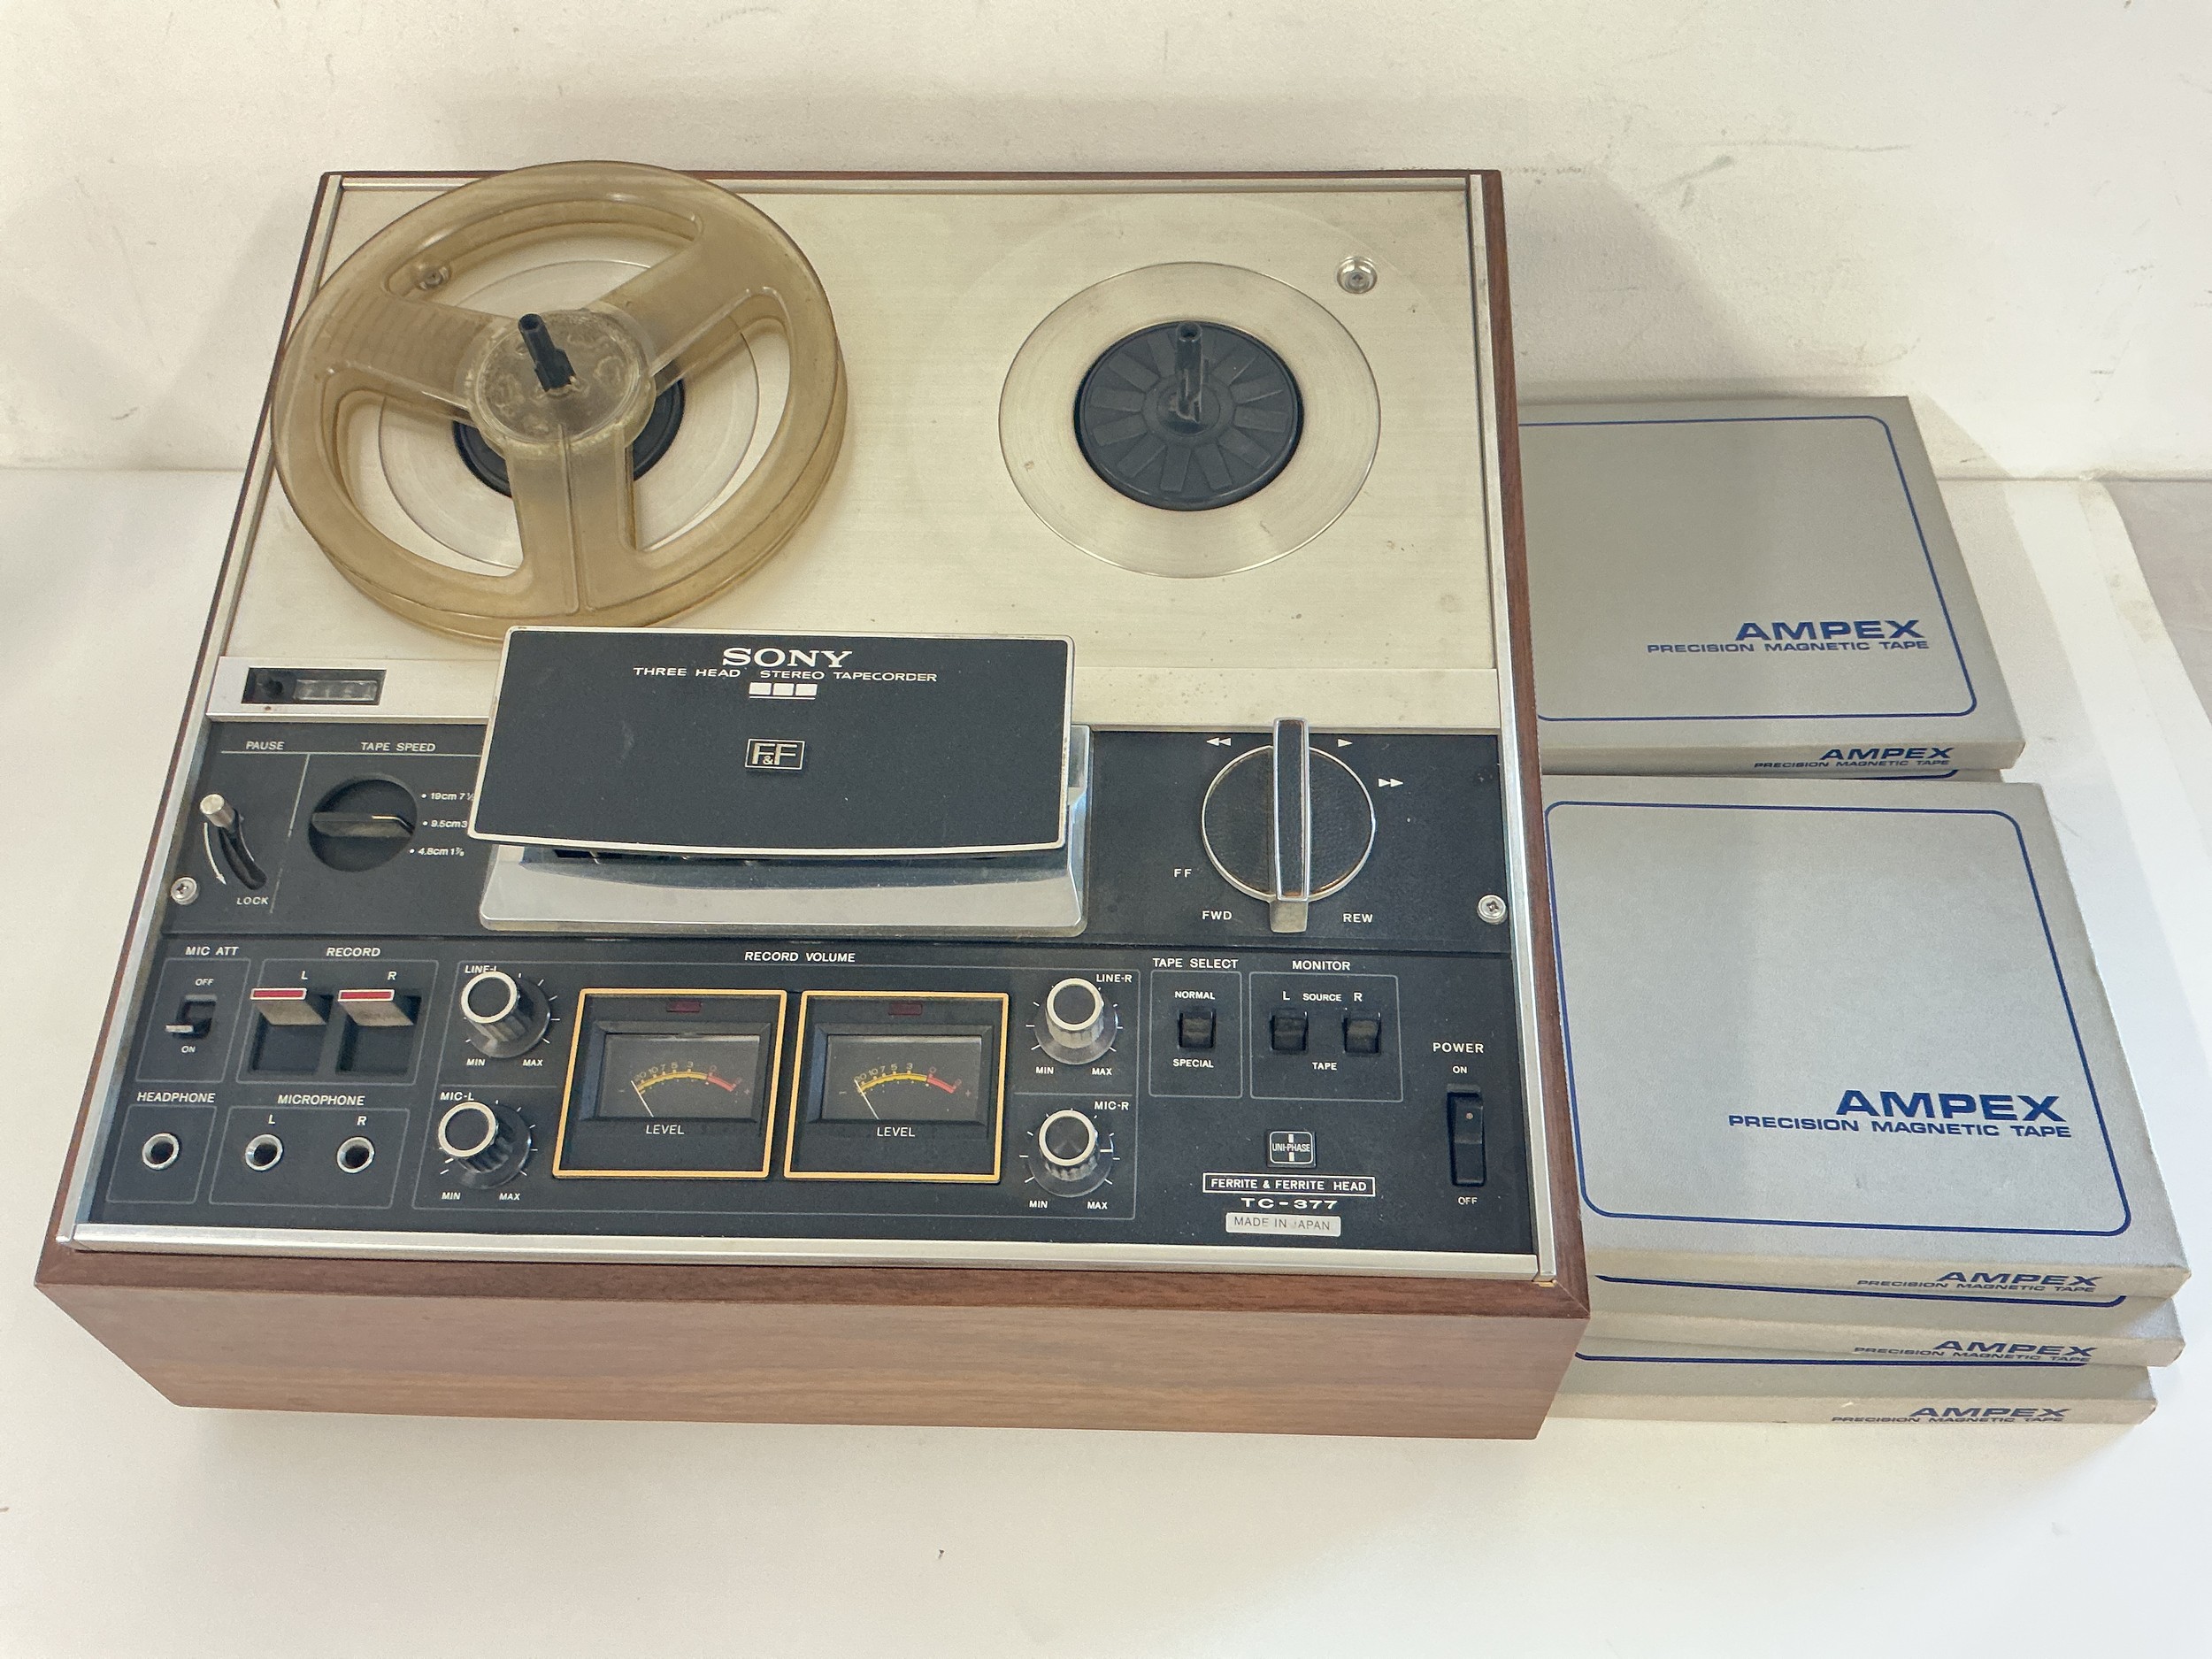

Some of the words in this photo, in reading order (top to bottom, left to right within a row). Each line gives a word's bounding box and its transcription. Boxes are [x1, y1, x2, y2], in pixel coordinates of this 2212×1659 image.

[1735, 620, 1924, 641] AMPEX
[1647, 644, 1754, 653] PRECISION
[1765, 641, 1870, 651] MAGNETIC
[1879, 641, 1929, 649] TAPE
[722, 647, 852, 668] SONY
[633, 667, 687, 676] THREE
[760, 670, 825, 680] STEREO
[833, 672, 937, 682] TAPECORDER
[246, 741, 285, 750] PAUSE
[361, 741, 390, 751] TAPE
[396, 742, 435, 752] SPEED
[1820, 748, 1955, 760] AMPEX
[237, 896, 268, 905] LOCK
[1202, 910, 1233, 920] FWD
[1343, 913, 1373, 923] REW
[185, 947, 210, 956] MIC
[216, 947, 239, 956] ATT
[326, 948, 380, 957] RECORD
[744, 951, 798, 962] RECORD
[806, 952, 856, 963] VOLUME
[1153, 958, 1183, 969] TAPE
[1190, 957, 1238, 969] SELECT
[1292, 960, 1350, 972] MONITOR
[302, 971, 308, 980] L
[388, 972, 396, 980] R
[1095, 974, 1132, 983] LINE-R
[1174, 990, 1215, 1000] NORMAL
[1283, 992, 1290, 1001] L
[1354, 992, 1362, 1002] R
[1432, 1042, 1484, 1054] POWER
[1173, 1058, 1214, 1068] SPECIAL
[1312, 1062, 1337, 1071] TAPE
[1036, 1066, 1054, 1075] MIN
[1092, 1066, 1112, 1076] MAX
[137, 1093, 215, 1103] HEADPHONE
[278, 1094, 365, 1106] MICROPHONE
[441, 1092, 474, 1101] MIC-L
[1094, 1101, 1129, 1110] MIC-R
[1835, 1090, 2068, 1122] AMPEX
[269, 1115, 275, 1125] L
[357, 1116, 366, 1125] R
[646, 1125, 684, 1134] LEVEL
[877, 1126, 915, 1137] LEVEL
[1729, 1115, 1859, 1131] PRECISION
[1871, 1121, 2000, 1136] MAGNETIC
[2010, 1125, 2071, 1138] TAPE
[1271, 1143, 1310, 1153] UNI-PHASE
[1210, 1179, 1258, 1189] FERRITE
[1263, 1179, 1270, 1188] &
[1275, 1179, 1325, 1191] FERRITE
[1333, 1181, 1366, 1191] HEAD
[1029, 1200, 1048, 1209] MIN
[1087, 1201, 1108, 1210] MAX
[1240, 1198, 1339, 1210] TC-377
[1458, 1196, 1478, 1205] OFF
[1234, 1217, 1269, 1226] MADE
[1275, 1219, 1286, 1228] IN
[1857, 1279, 1948, 1288] PRECISION
[1936, 1271, 2102, 1286] AMPEX
[1933, 1340, 2097, 1357] AMPEX
[1855, 1348, 1944, 1356] PRECISION
[1953, 1352, 2041, 1361] MAGNETIC
[1909, 1407, 2072, 1417] AMPEX
